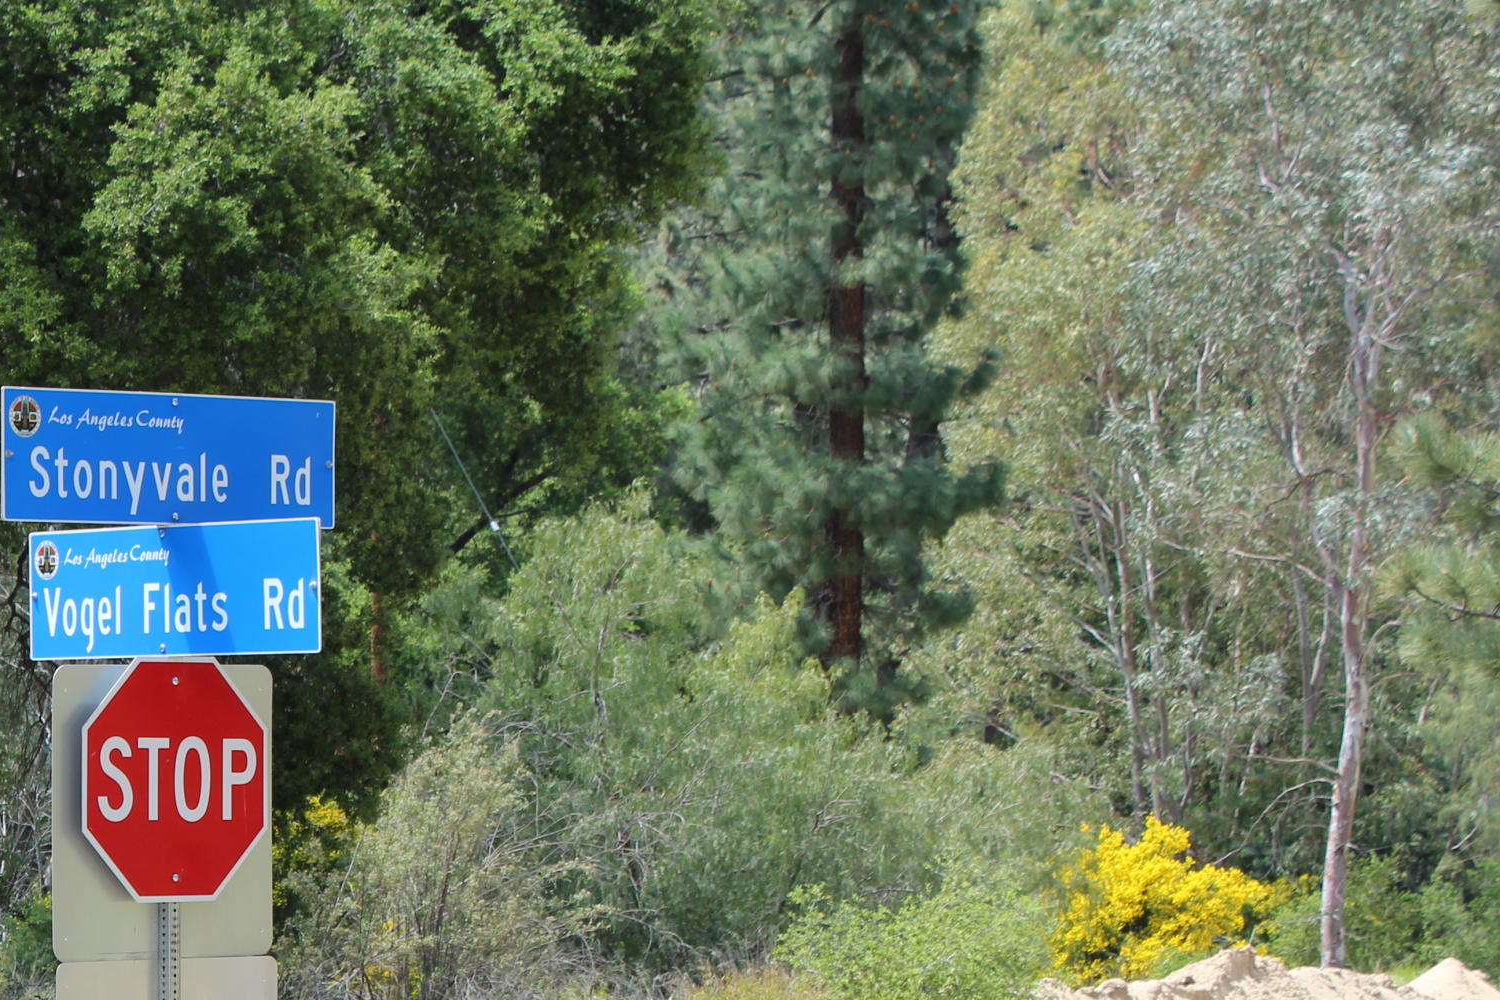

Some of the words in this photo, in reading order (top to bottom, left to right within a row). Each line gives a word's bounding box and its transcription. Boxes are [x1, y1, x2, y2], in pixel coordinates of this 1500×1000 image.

[47, 405, 73, 425] Los
[76, 407, 133, 431] Angeles
[136, 410, 185, 434] County
[28, 445, 229, 515] Stonyvale
[270, 454, 311, 506] Rd
[63, 547, 83, 566] Los
[84, 547, 128, 569] Angeles
[130, 544, 170, 566] County
[44, 584, 121, 653] Vogel
[143, 581, 229, 634] Flats
[263, 577, 305, 630] Rd
[97, 735, 258, 823] STOP
